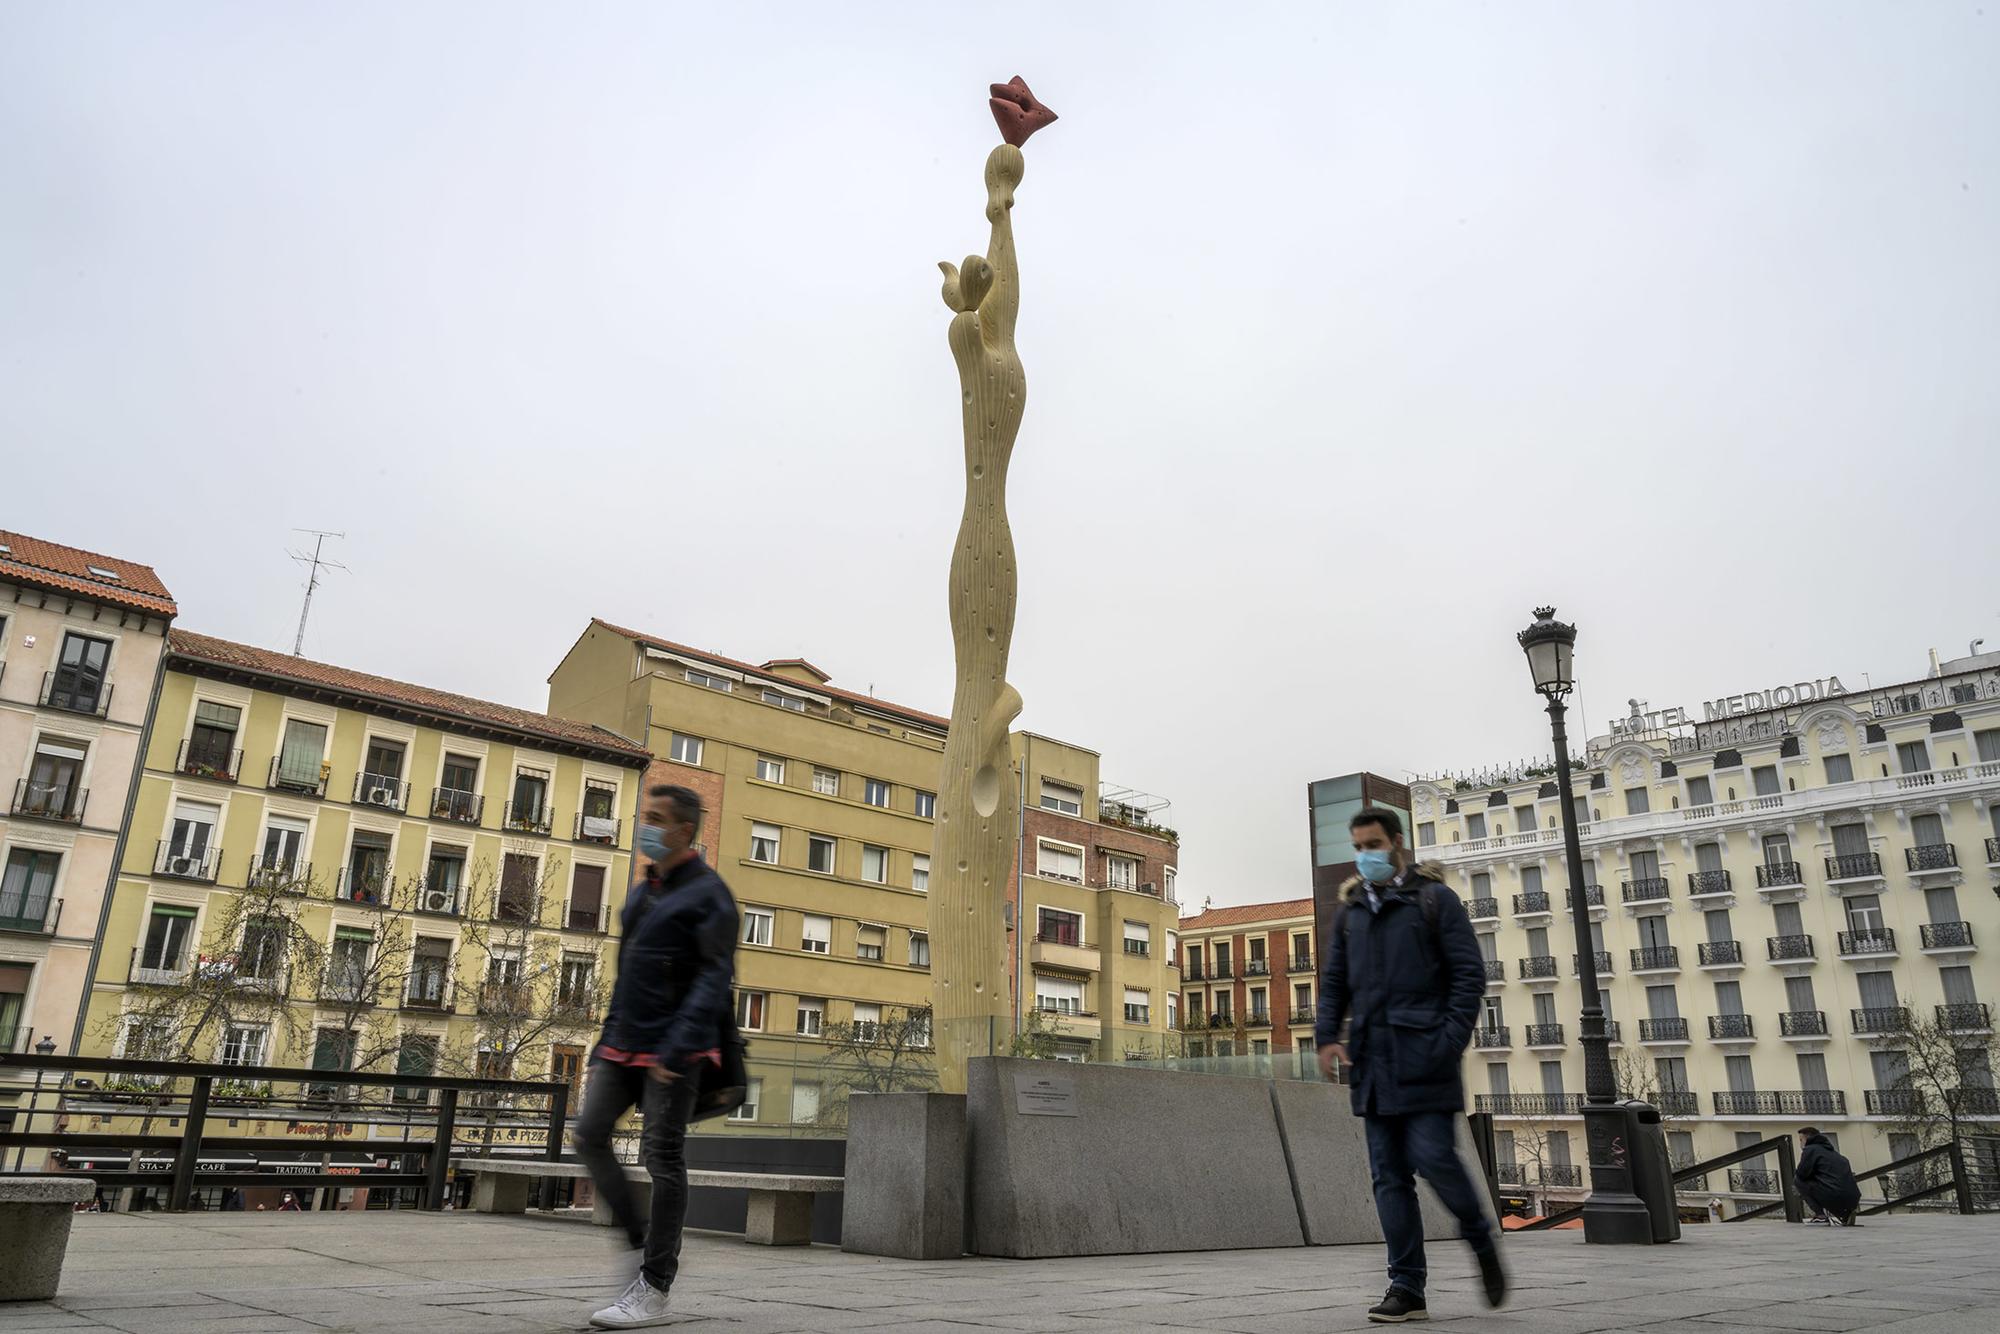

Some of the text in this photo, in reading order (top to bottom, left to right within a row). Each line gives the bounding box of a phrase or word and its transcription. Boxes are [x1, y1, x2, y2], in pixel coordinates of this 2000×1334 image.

[1609, 676, 1851, 738] HOTEL MEDIODIA
[520, 1131, 549, 1141] PIZZ
[275, 1166, 316, 1175] TRATTORIA
